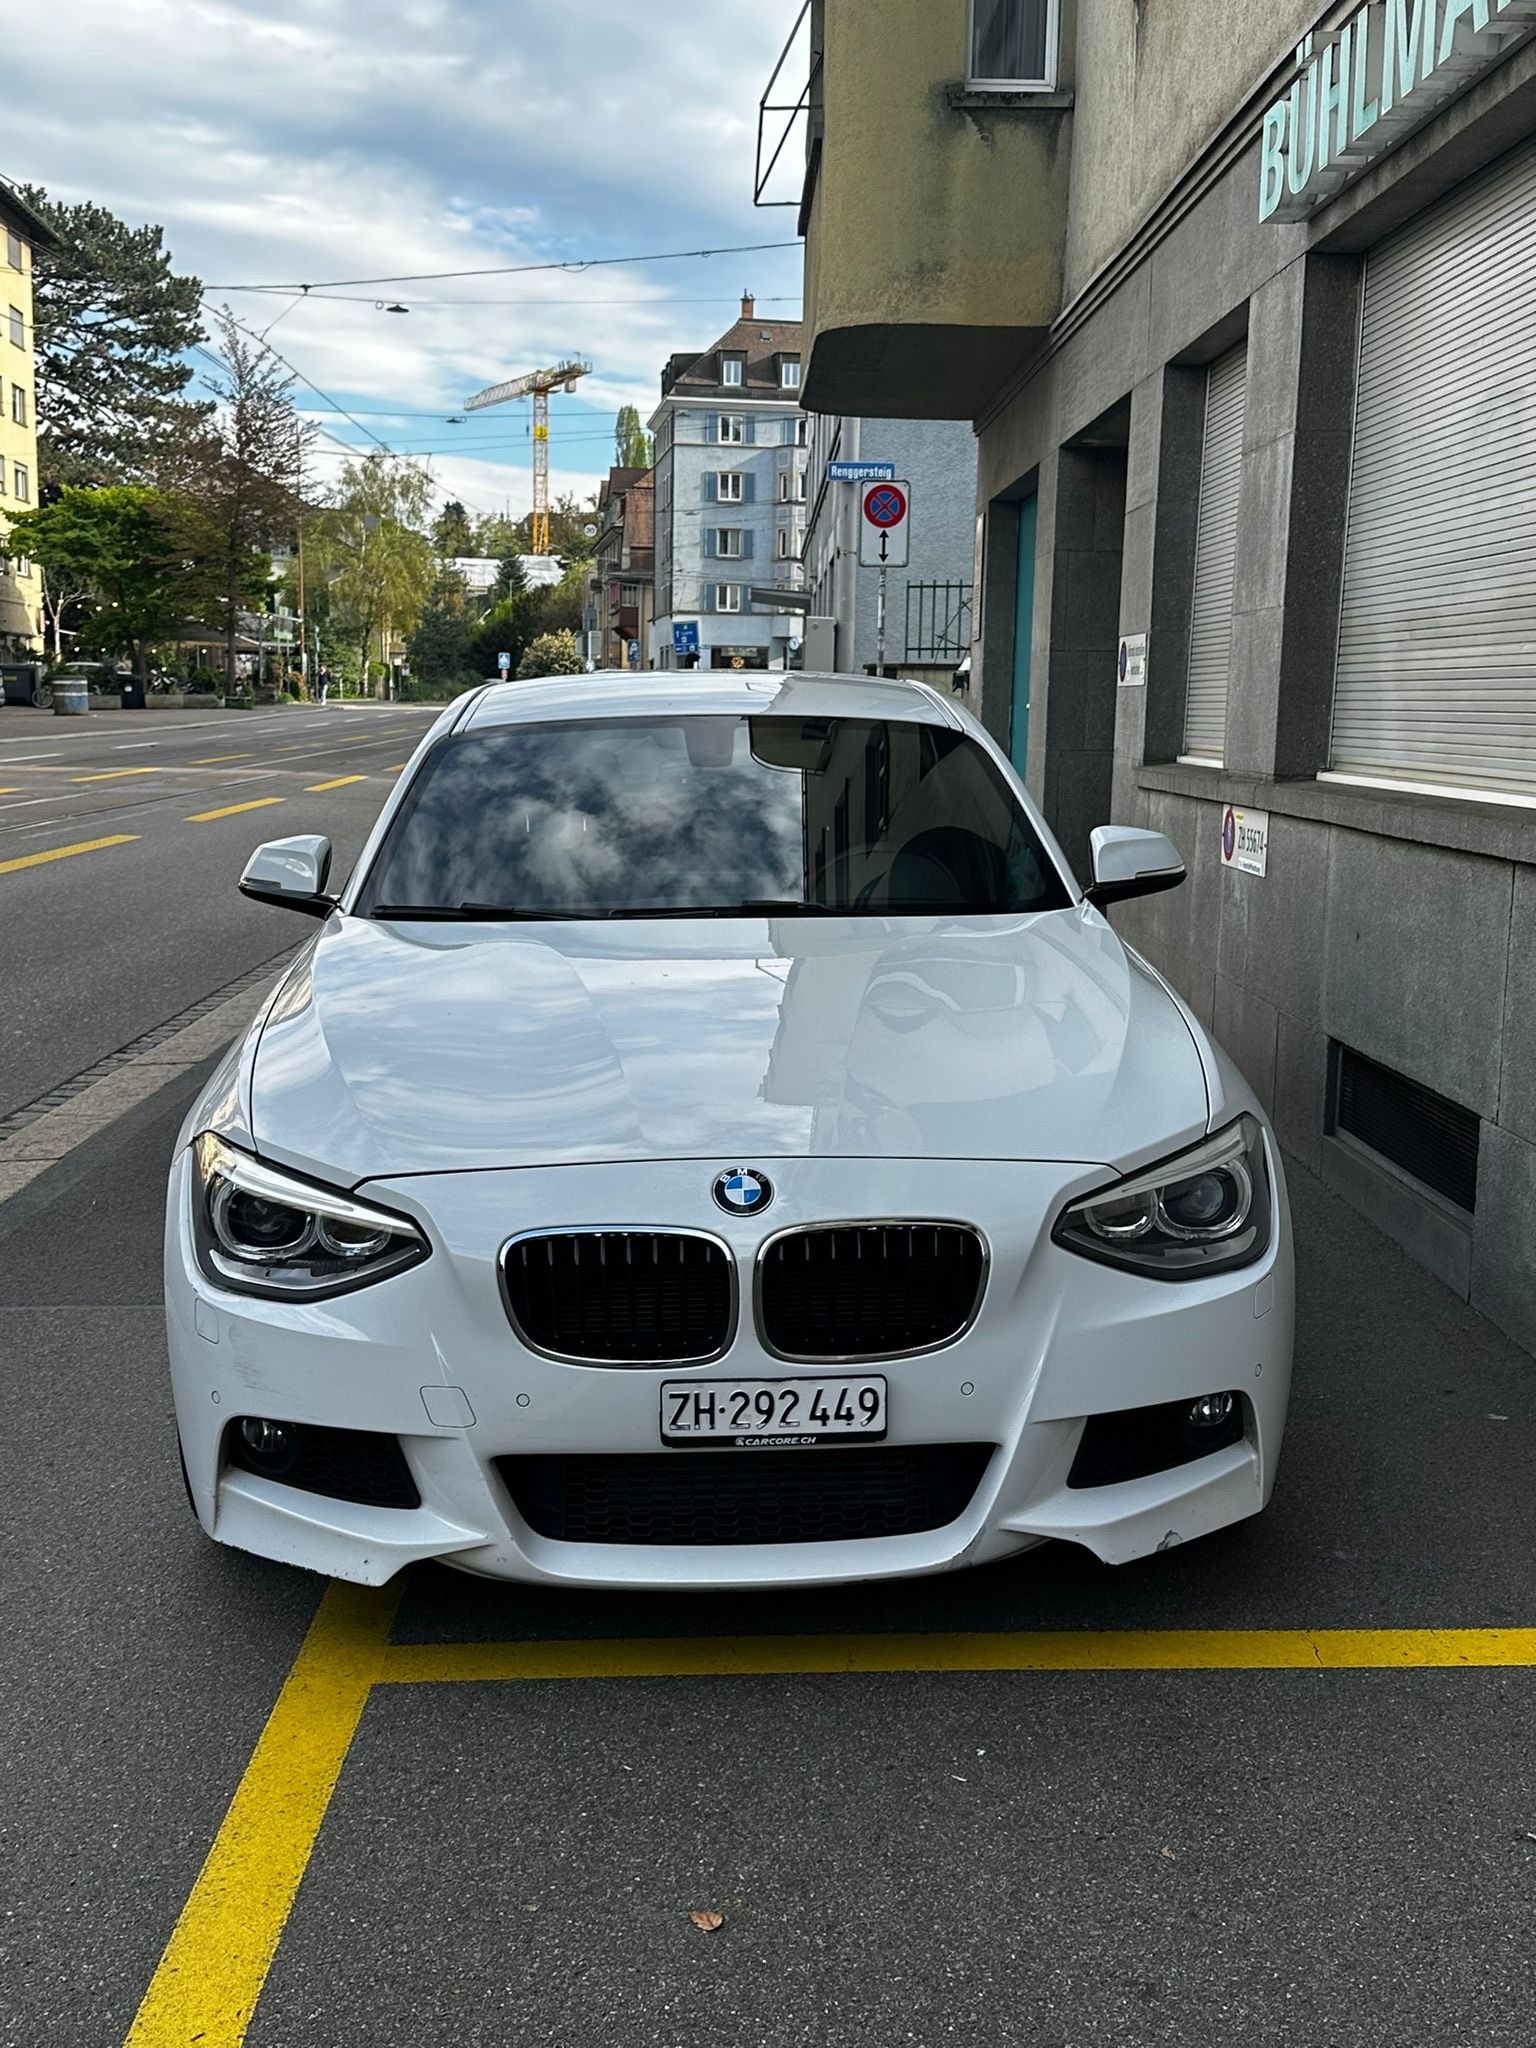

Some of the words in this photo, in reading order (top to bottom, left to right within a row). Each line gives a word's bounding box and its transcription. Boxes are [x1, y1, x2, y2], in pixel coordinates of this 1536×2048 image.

[831, 465, 892, 480] Renggersteig
[720, 1168, 767, 1183] BMW
[744, 1436, 817, 1447] CARCORE.CH
